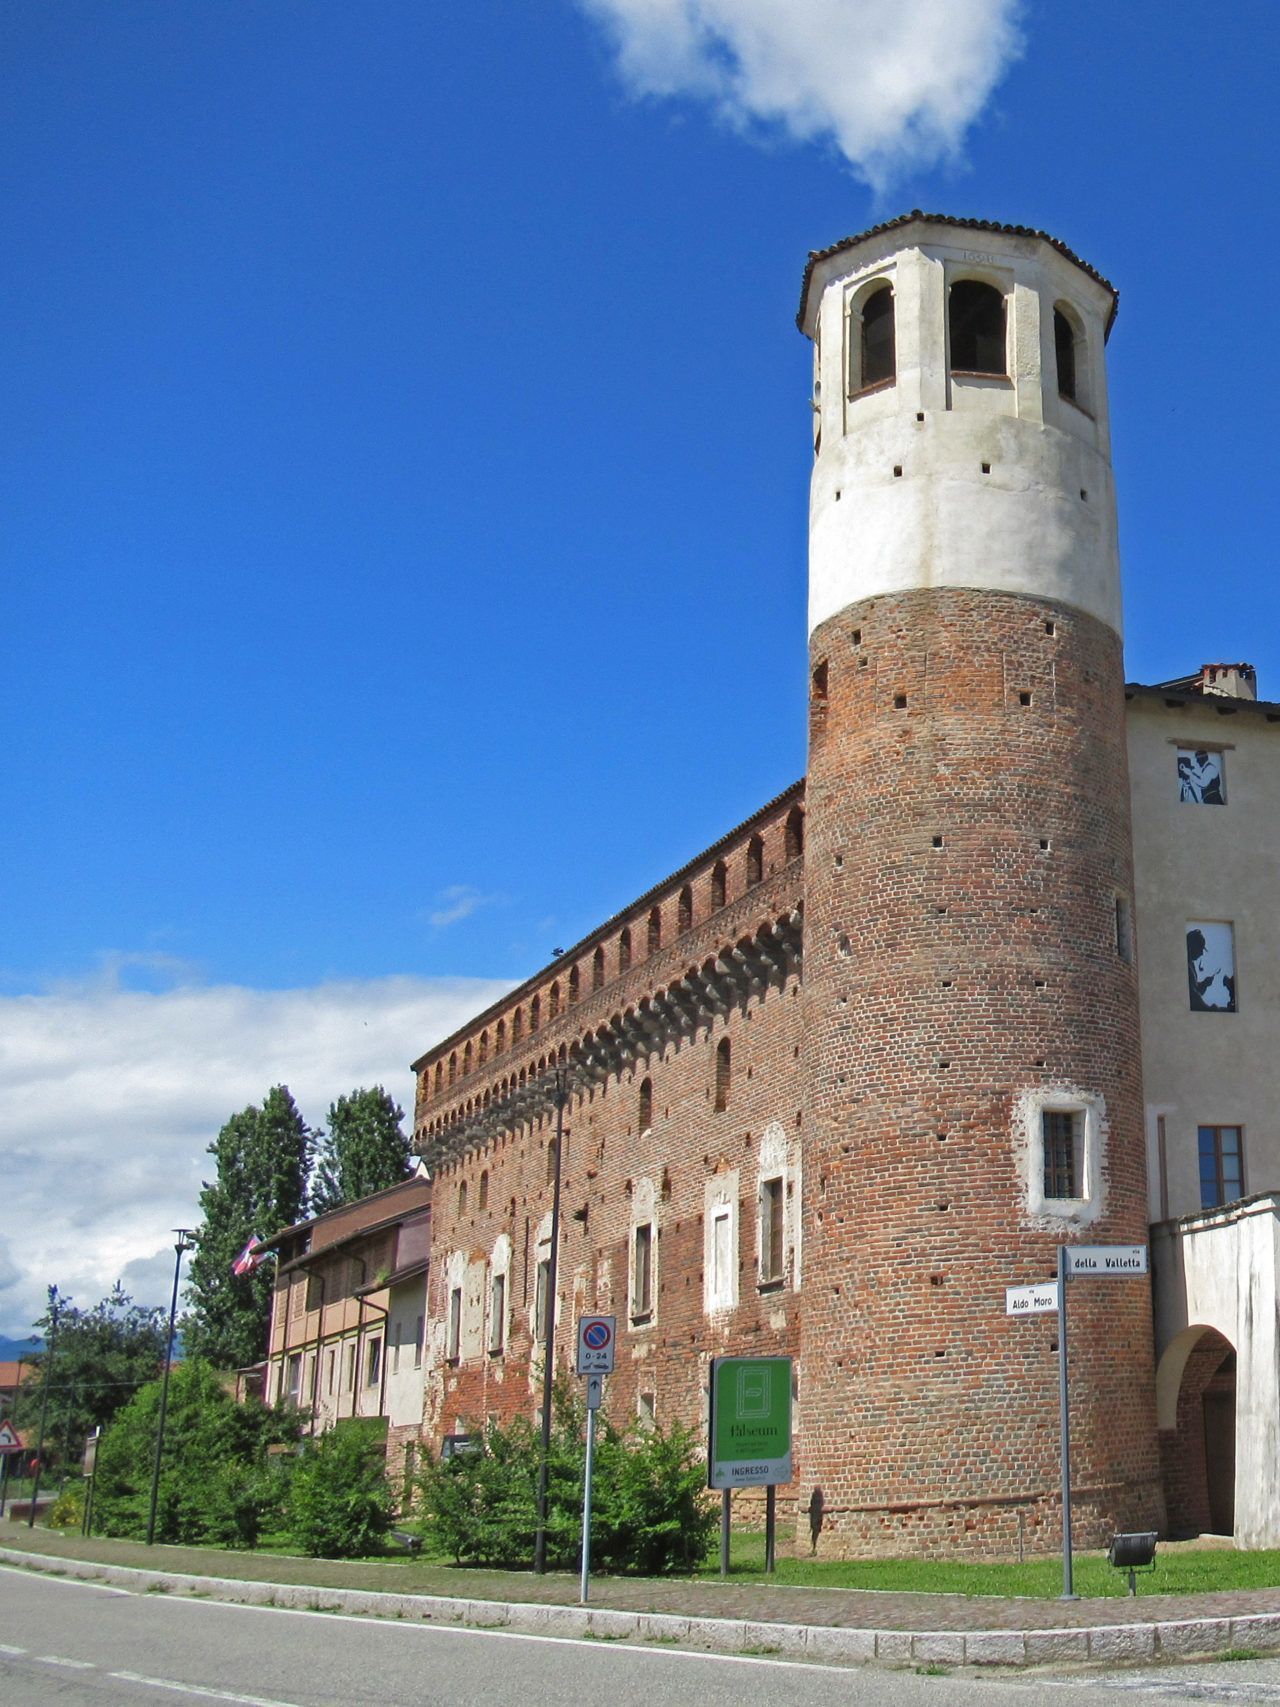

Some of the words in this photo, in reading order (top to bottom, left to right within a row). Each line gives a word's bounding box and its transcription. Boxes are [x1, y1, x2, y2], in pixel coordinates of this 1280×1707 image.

[1075, 1258, 1097, 1268] della
[1105, 1258, 1140, 1268] Valletta
[1013, 1299, 1029, 1309] Aldo
[1034, 1297, 1052, 1307] Moro
[731, 1465, 769, 1476] INGRESSO
